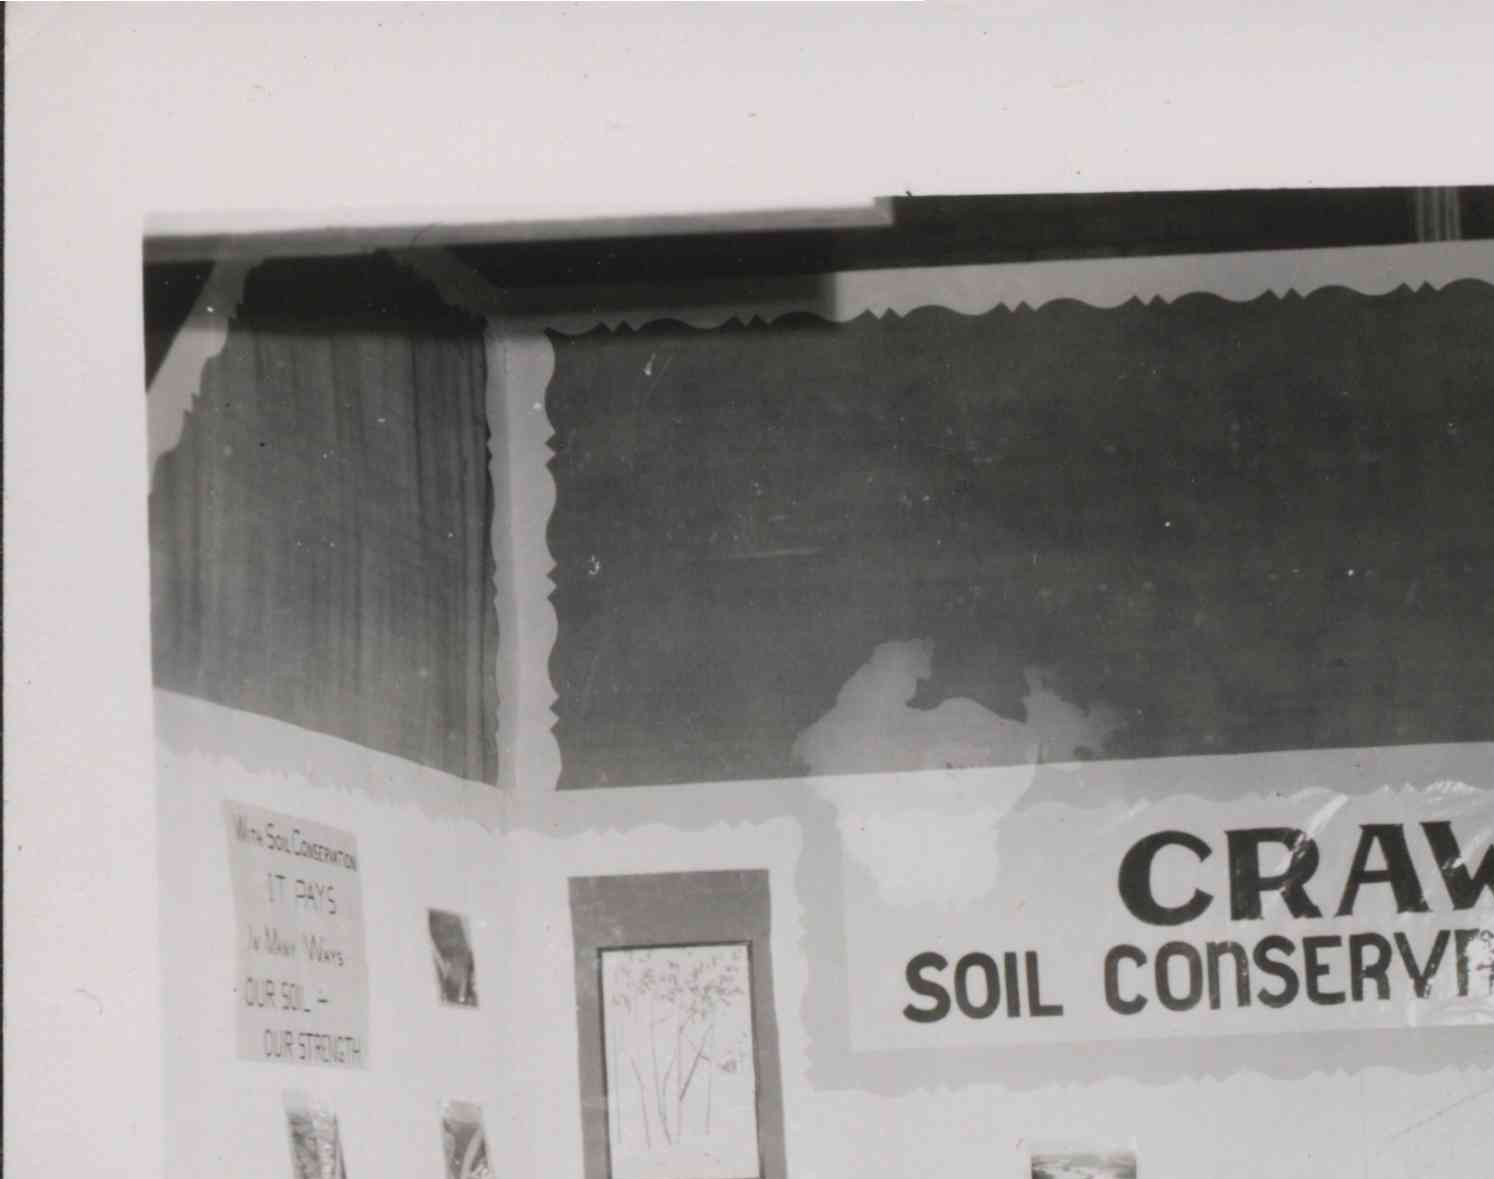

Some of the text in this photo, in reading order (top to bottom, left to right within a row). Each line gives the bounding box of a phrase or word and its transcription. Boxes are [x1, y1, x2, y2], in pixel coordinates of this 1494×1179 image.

[266, 872, 337, 916] IT PAYS
[902, 950, 1064, 1023] SOIL
